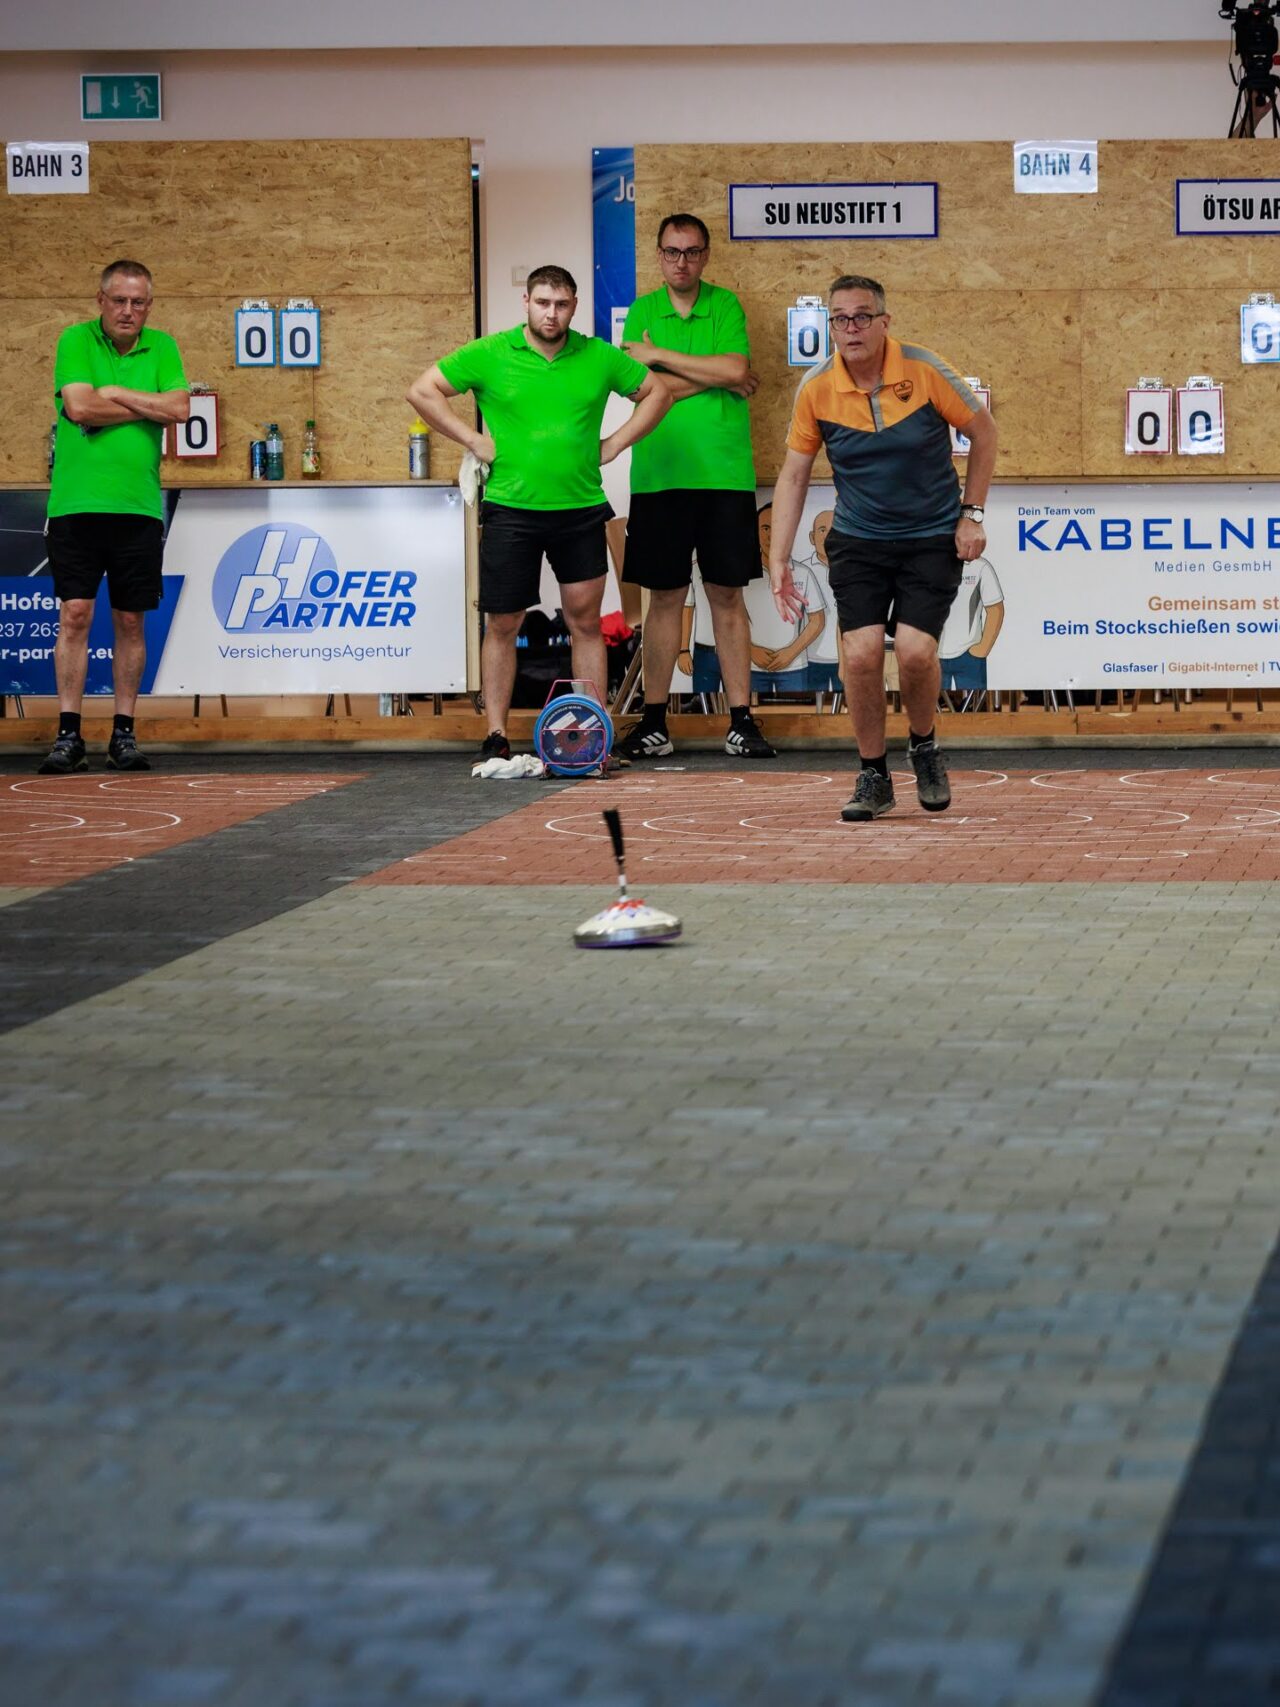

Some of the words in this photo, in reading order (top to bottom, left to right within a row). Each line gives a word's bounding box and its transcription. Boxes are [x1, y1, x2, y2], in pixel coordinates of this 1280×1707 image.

[12, 154, 62, 177] BAHN
[71, 154, 83, 177] 3
[1019, 152, 1070, 176] BAHN
[1079, 152, 1091, 176] 4
[764, 202, 791, 225] SU
[796, 202, 887, 224] NEUSTIFT
[892, 202, 902, 223] 1
[1203, 194, 1254, 220] ÖTSU
[245, 326, 267, 358] 0
[289, 326, 311, 358] 0
[798, 326, 820, 357] 0
[1251, 322, 1273, 354] 0
[185, 415, 208, 450] 0
[1137, 411, 1160, 446] 0
[1188, 410, 1212, 442] 0
[1018, 507, 1041, 516] Dein
[1044, 506, 1071, 515] Team
[1074, 507, 1096, 515] vom
[1154, 561, 1205, 572] Medien
[1212, 560, 1272, 572] GesmbH
[224, 573, 417, 629] PARTNER
[1148, 596, 1256, 611] Gemeinsam
[1043, 620, 1089, 635] Beim
[1095, 619, 1230, 634] Stockschießen
[217, 645, 412, 661] VersicherungsAgentur
[1103, 662, 1158, 673] Glasfaser
[1168, 662, 1259, 674] Gigabit-Internet
